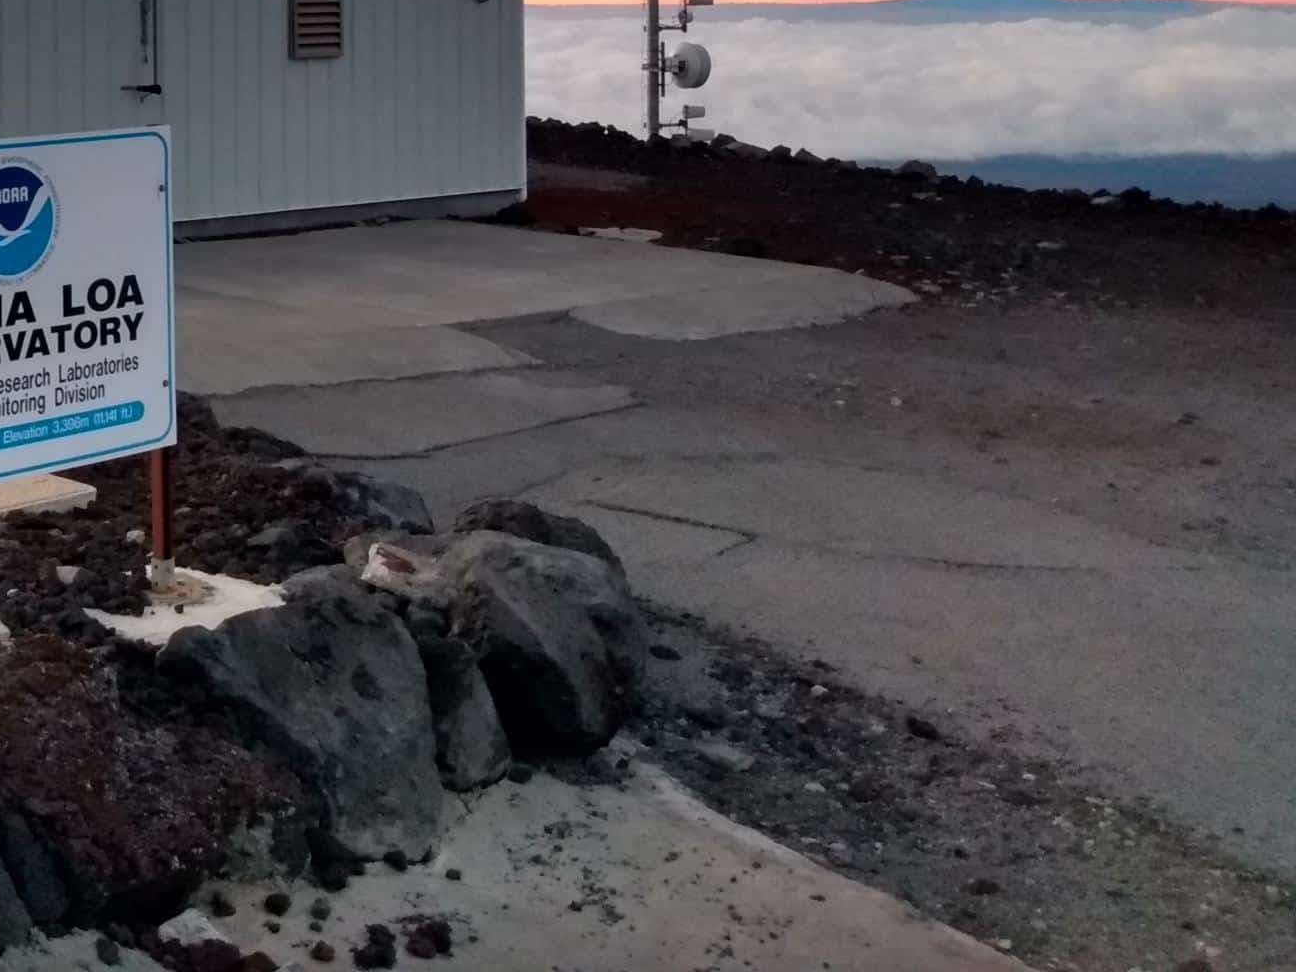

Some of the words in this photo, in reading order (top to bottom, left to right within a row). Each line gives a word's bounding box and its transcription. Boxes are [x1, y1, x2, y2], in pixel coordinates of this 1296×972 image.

[62, 274, 144, 318] LOA
[58, 353, 139, 383] Laboratories
[54, 381, 105, 406] Division
[3, 425, 48, 444] Elevation
